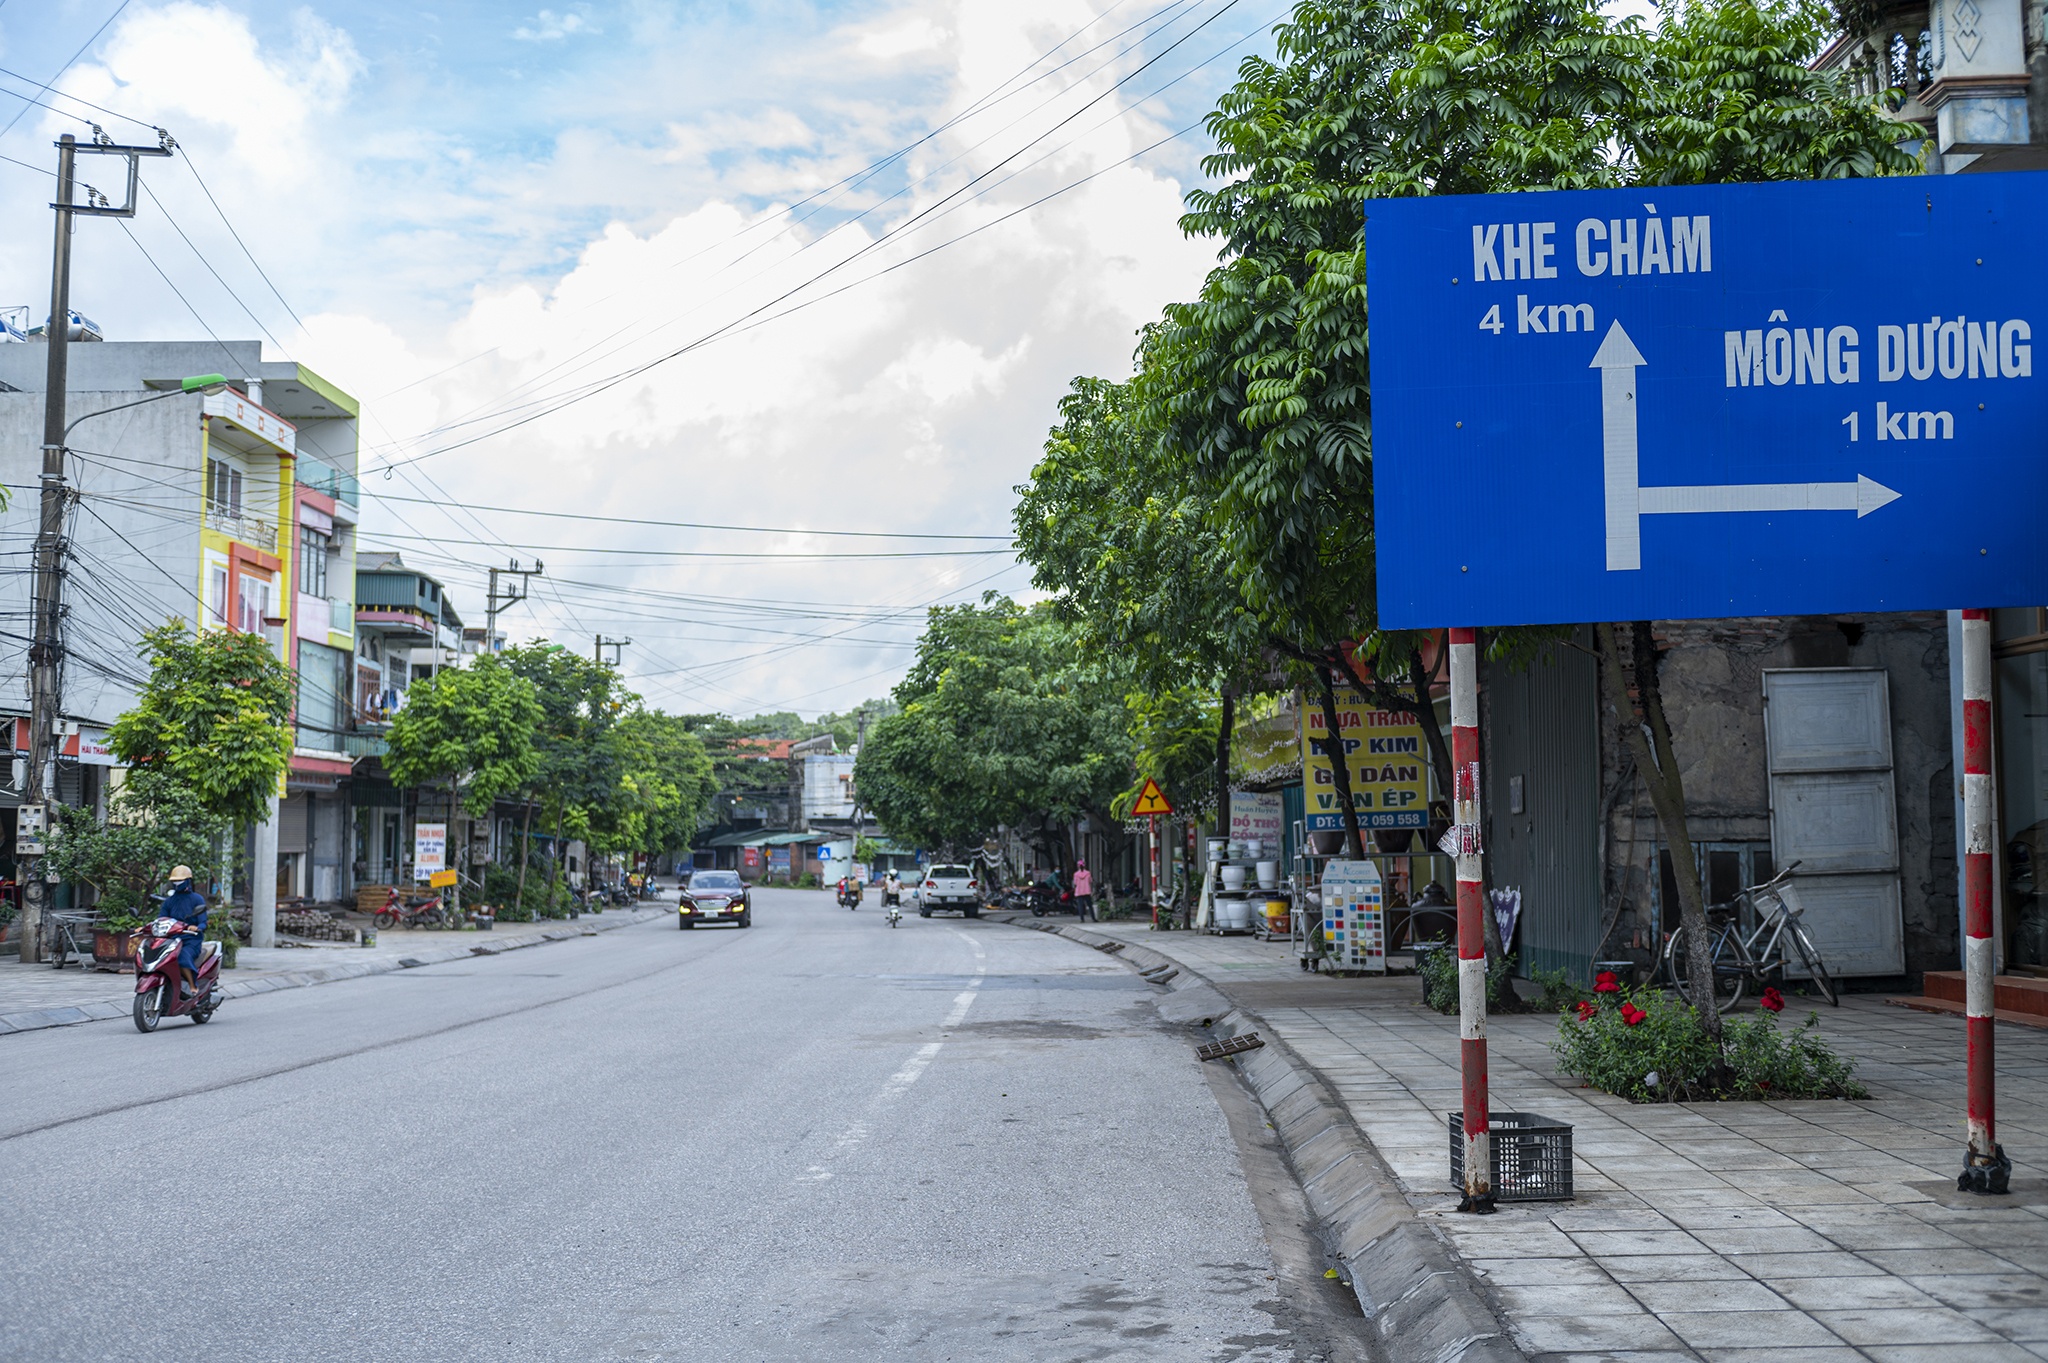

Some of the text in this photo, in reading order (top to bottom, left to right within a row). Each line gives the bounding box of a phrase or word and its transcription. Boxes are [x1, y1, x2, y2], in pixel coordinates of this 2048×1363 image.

[1472, 203, 1712, 282] KHE CHÀM
[1479, 294, 1595, 335] 4 km
[1725, 309, 2032, 388] MÔNG DƯƠNG
[1842, 401, 1954, 442] 1 km
[1370, 737, 1418, 754] KIM
[1360, 763, 1418, 783] DÁN
[1382, 788, 1417, 807] ÉP
[1316, 816, 1336, 828] ĐT:
[1372, 815, 1394, 826] 059
[1398, 813, 1420, 826] 558
